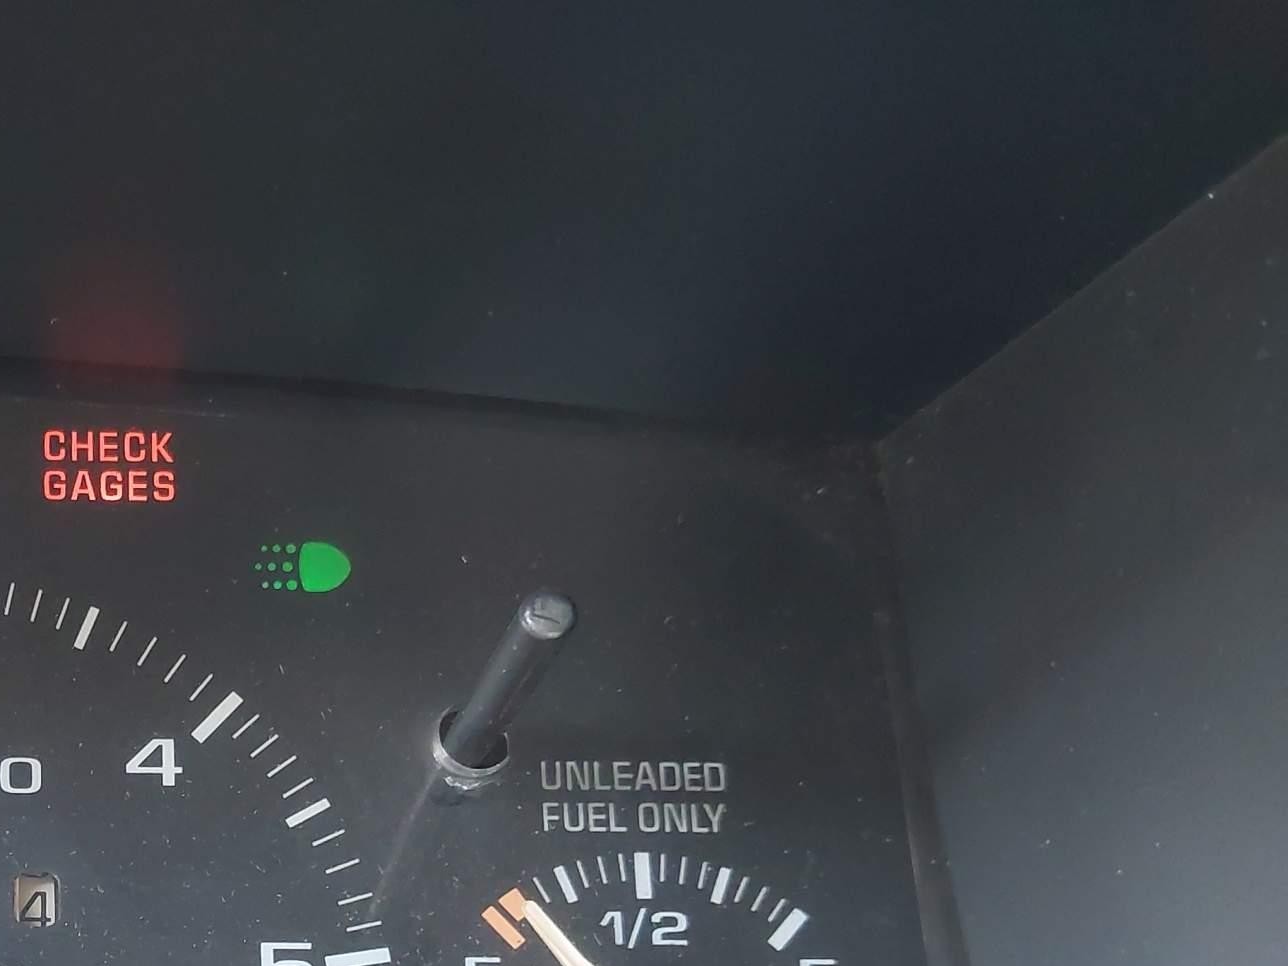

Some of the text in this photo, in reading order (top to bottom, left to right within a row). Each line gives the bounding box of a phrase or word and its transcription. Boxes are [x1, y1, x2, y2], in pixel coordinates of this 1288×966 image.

[43, 430, 175, 464] CHECK
[42, 470, 176, 502] GAGES
[125, 738, 183, 787] 4
[540, 760, 726, 793] UNLEADED
[542, 802, 726, 834] FUEL ONLY
[599, 908, 688, 949] 1/2
